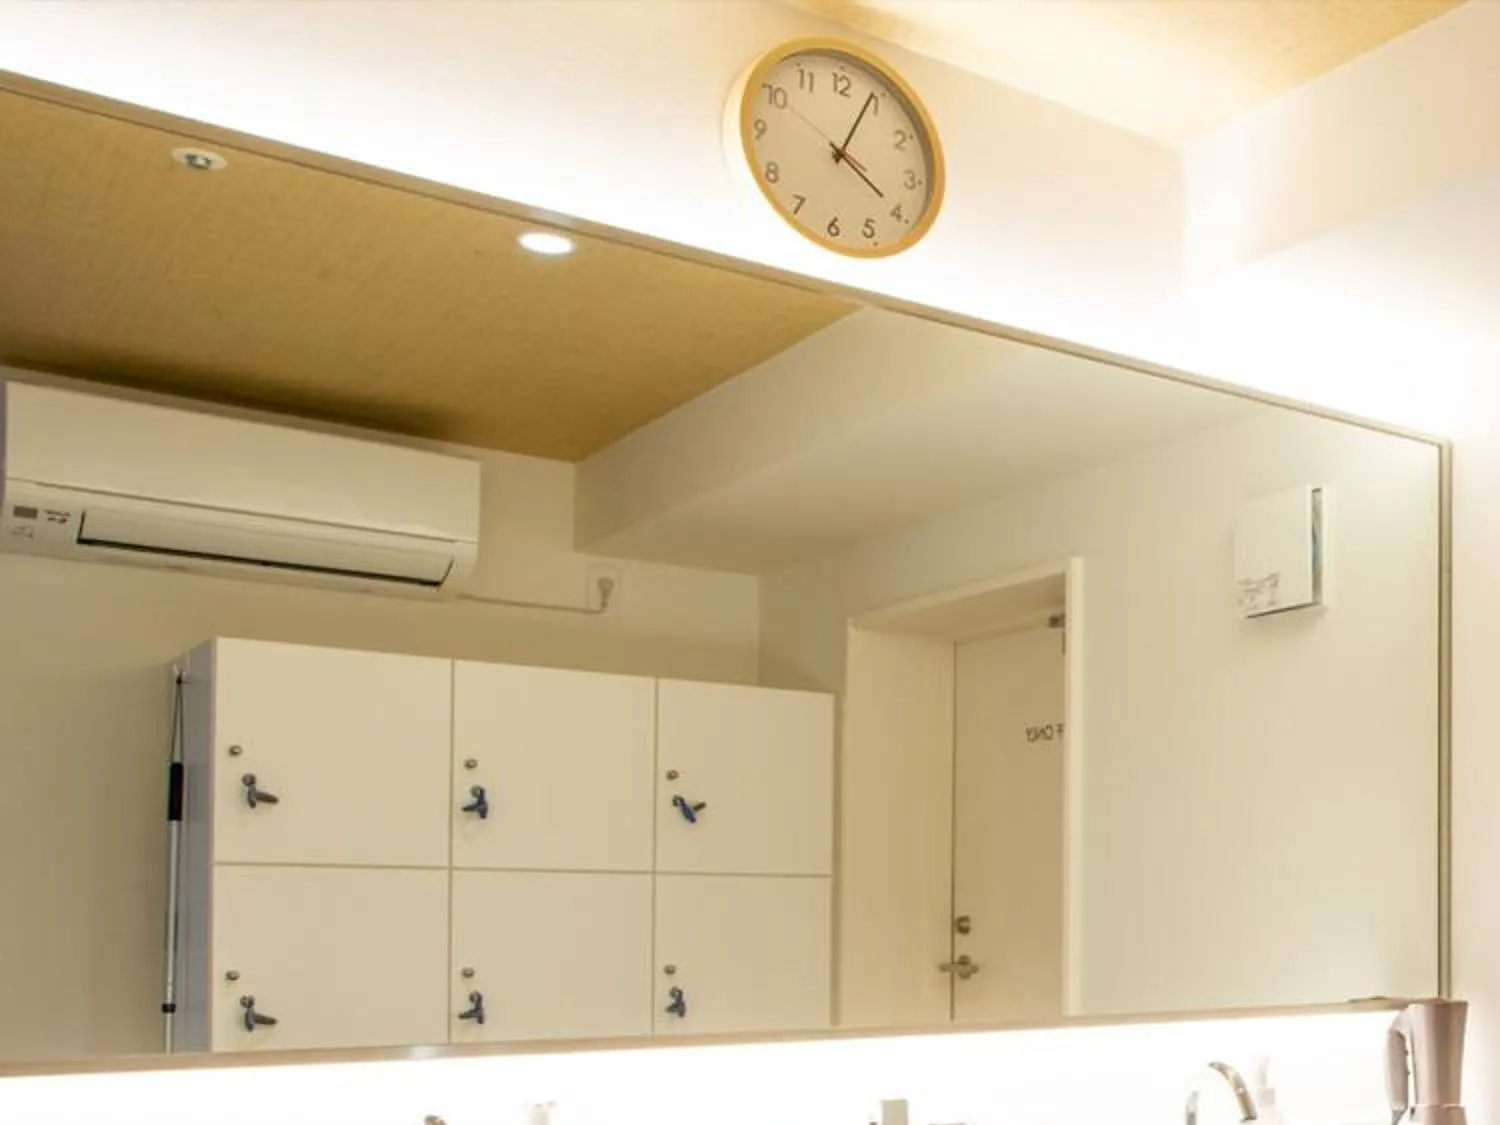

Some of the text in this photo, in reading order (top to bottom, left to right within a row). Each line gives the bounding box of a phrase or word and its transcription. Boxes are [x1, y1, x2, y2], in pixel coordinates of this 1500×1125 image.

[797, 68, 815, 93] 11
[832, 71, 851, 98] 12
[762, 83, 788, 110] 10
[753, 118, 767, 140] 9
[893, 129, 907, 151] 2
[764, 161, 780, 184] 8
[903, 169, 917, 190] 3
[792, 194, 806, 216] 7
[889, 204, 903, 223] 4
[827, 216, 840, 237] 6
[861, 218, 876, 239] 5
